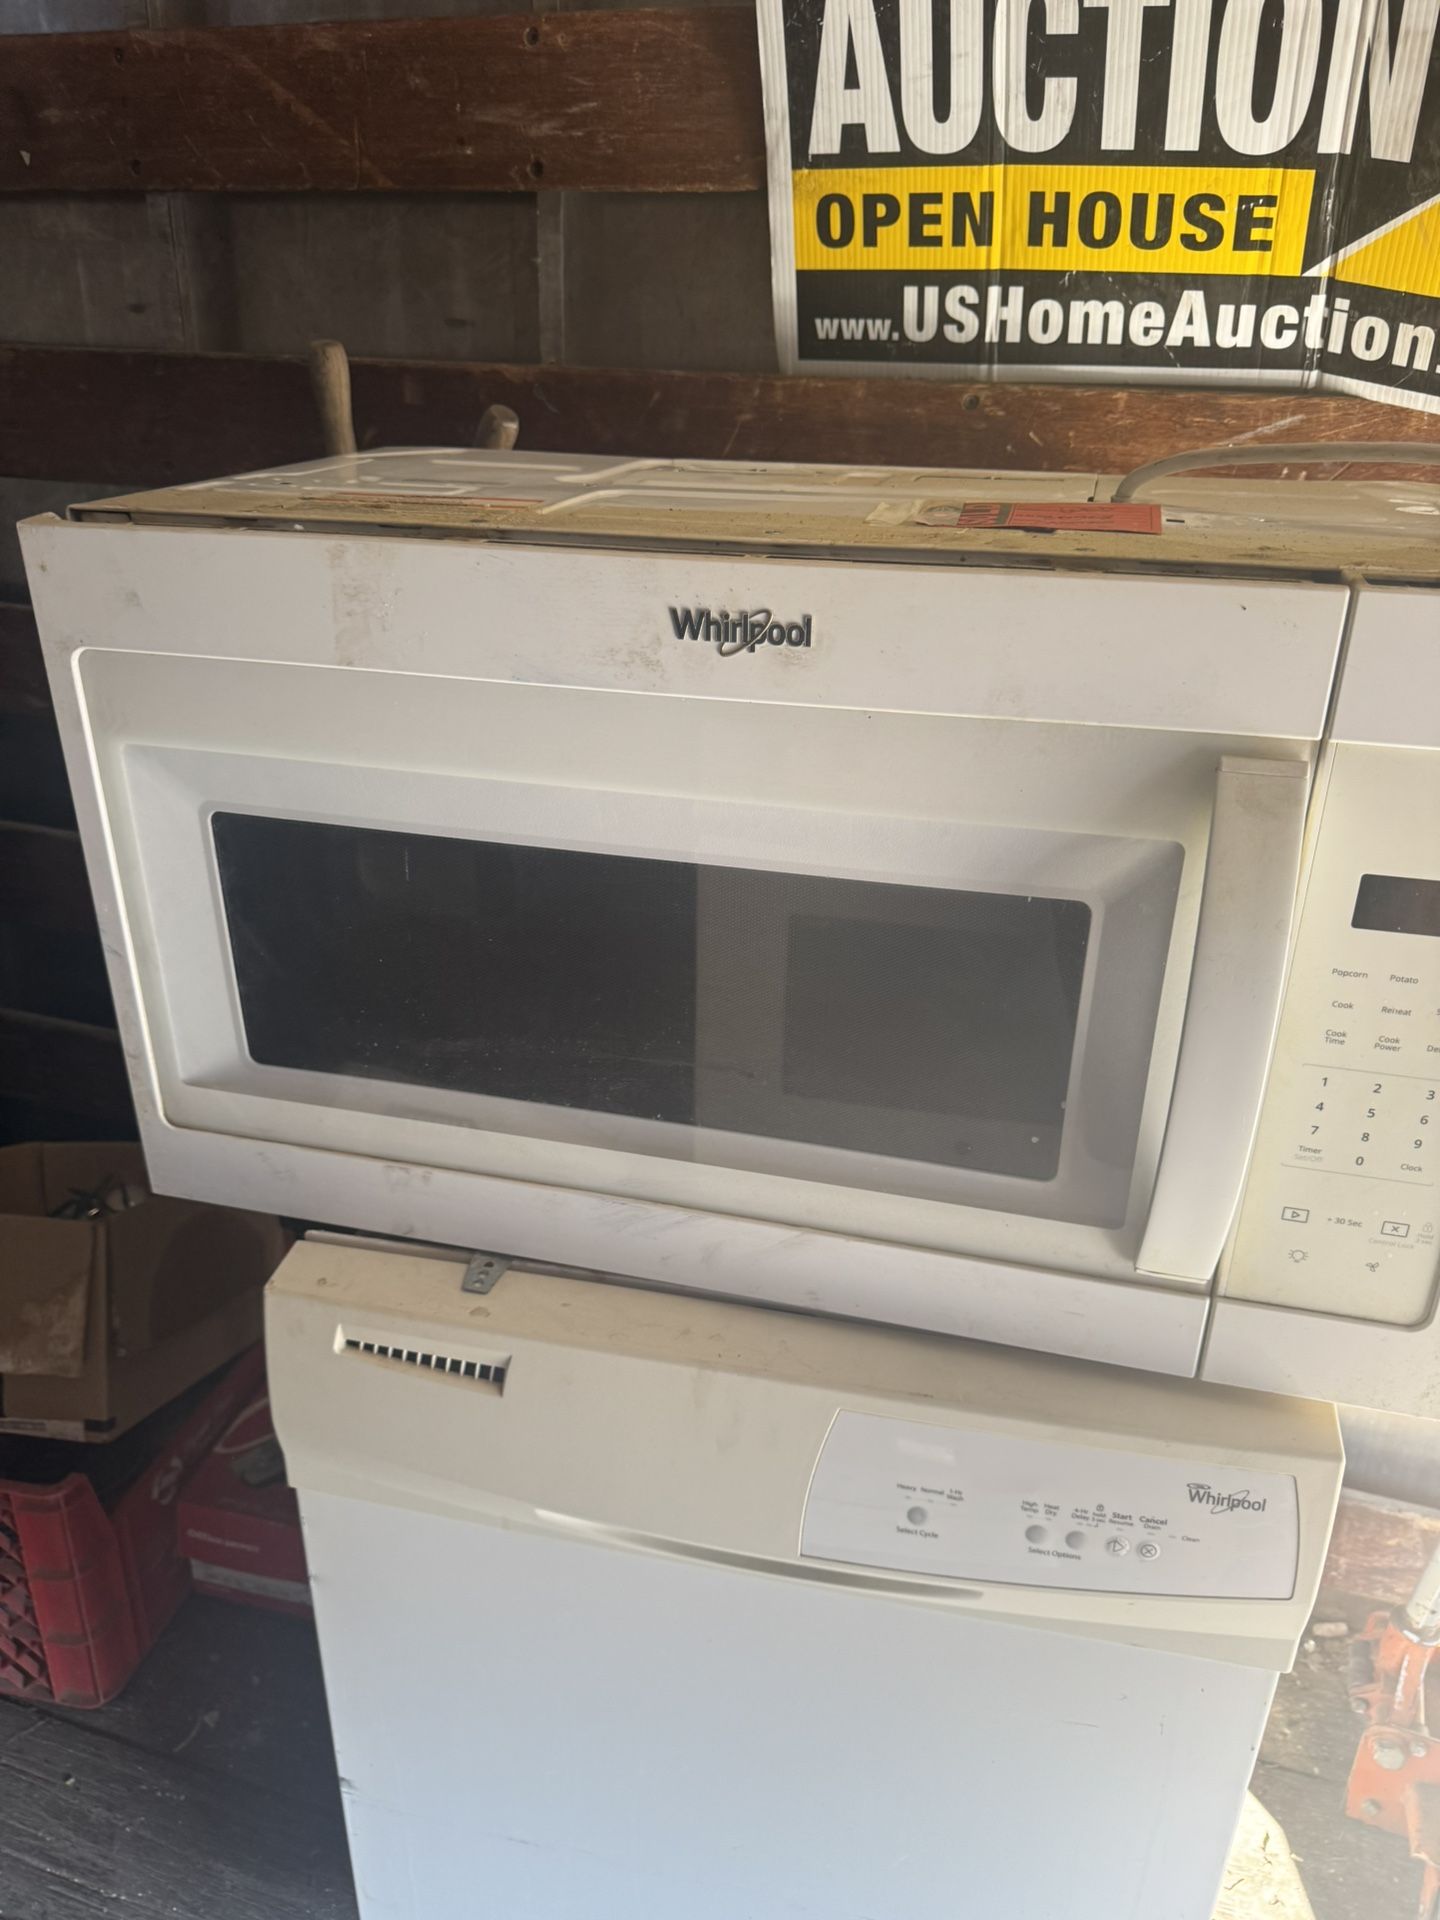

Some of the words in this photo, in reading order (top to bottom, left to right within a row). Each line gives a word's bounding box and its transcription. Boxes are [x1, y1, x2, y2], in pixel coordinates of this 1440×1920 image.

[808, 0, 1434, 164] AUCTION
[815, 190, 996, 249] OPEN
[1027, 191, 1279, 253] HOUSE
[815, 285, 1440, 374] www.USHomeAuction
[668, 606, 813, 656] Whirlpool
[1331, 968, 1369, 980] Popcorn
[1389, 974, 1419, 985] Potato
[1331, 1000, 1354, 1010] Cook
[1325, 1028, 1347, 1038] Cook
[1378, 1035, 1400, 1044] Cook
[1324, 1036, 1346, 1046] Time
[1374, 1042, 1402, 1053] Power
[1321, 1076, 1328, 1087] 1
[1372, 1083, 1382, 1094] 2
[1426, 1090, 1436, 1101] 3
[1315, 1101, 1324, 1111] 4
[1367, 1108, 1376, 1118] 5
[1420, 1115, 1429, 1125] 6
[1310, 1125, 1319, 1135] 7
[1361, 1132, 1370, 1142] 8
[1414, 1139, 1423, 1149] 9
[1299, 1145, 1322, 1154] Timer
[1355, 1156, 1364, 1166] 0
[1400, 1163, 1422, 1173] Clock
[1334, 1217, 1346, 1225] 30
[1347, 1219, 1363, 1228] Sec
[1188, 1488, 1267, 1514] Whirlpool
[1112, 1511, 1133, 1521] Start
[1139, 1514, 1168, 1526] Cancel
[896, 1525, 918, 1535] Select
[919, 1529, 939, 1539] Cycle
[1027, 1546, 1050, 1556] Select
[1051, 1550, 1082, 1560] Options
